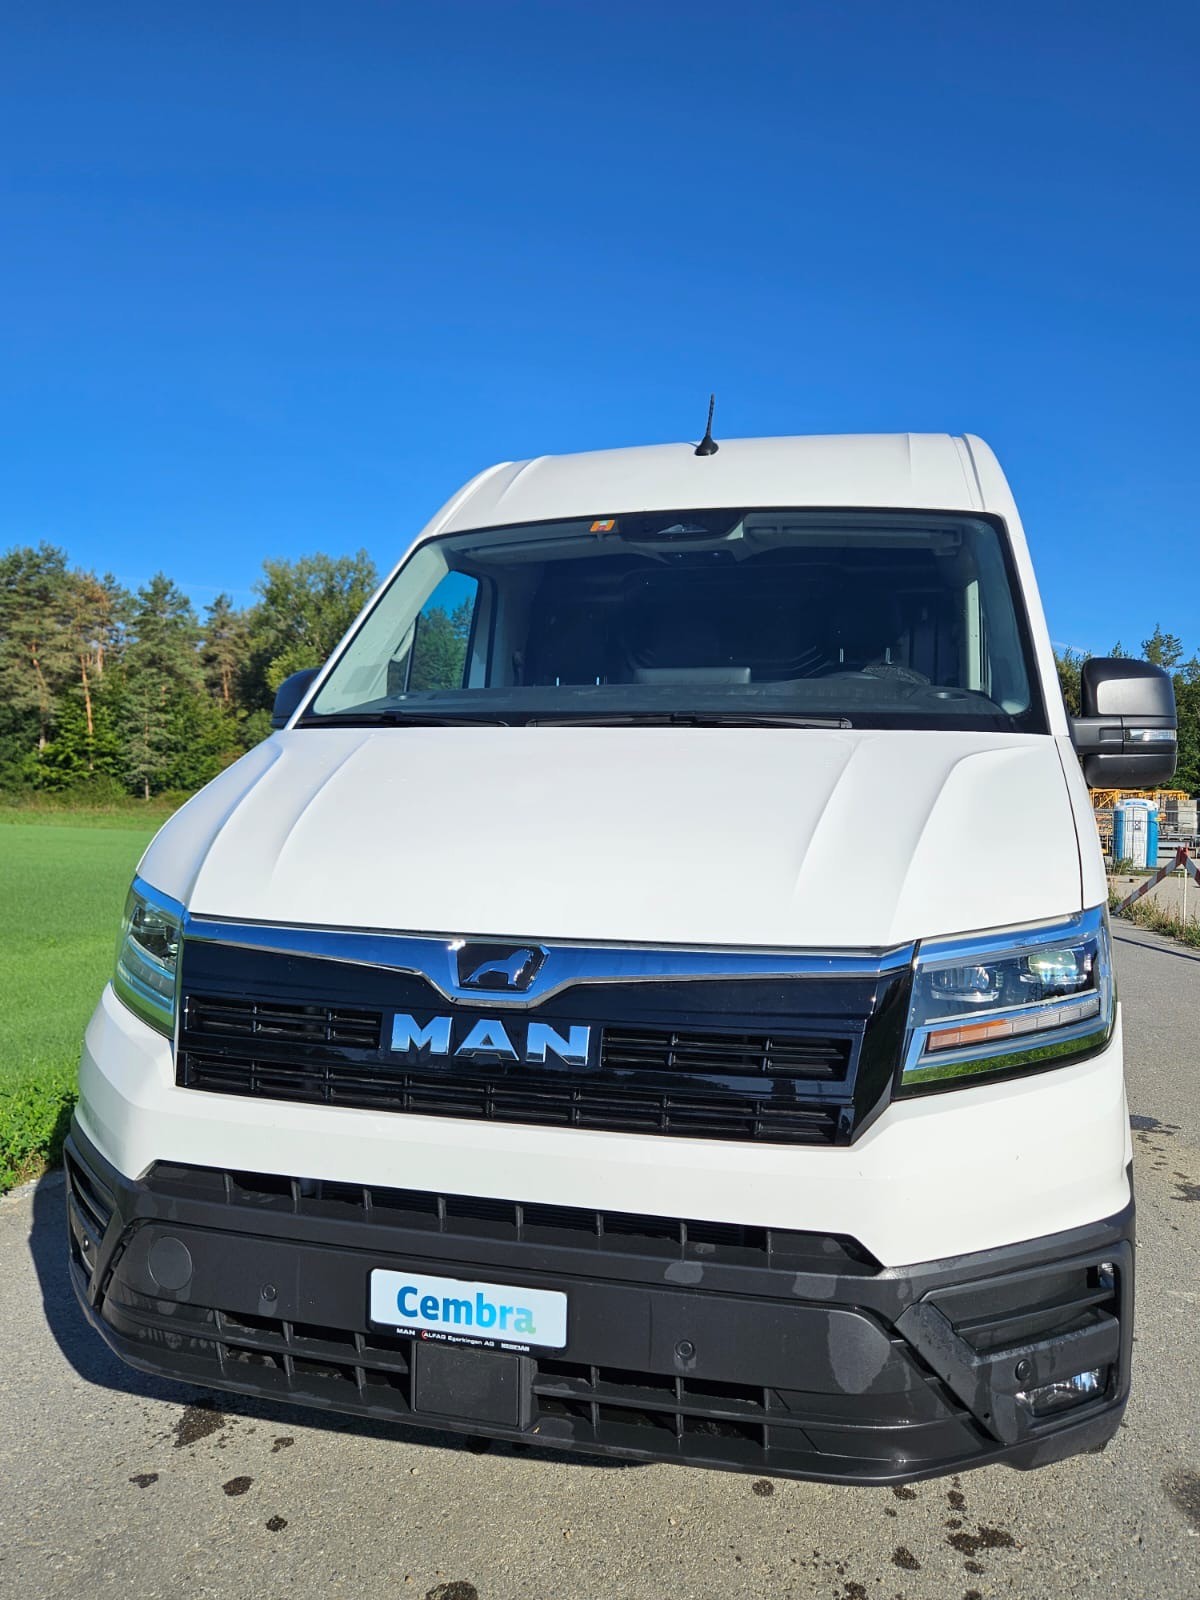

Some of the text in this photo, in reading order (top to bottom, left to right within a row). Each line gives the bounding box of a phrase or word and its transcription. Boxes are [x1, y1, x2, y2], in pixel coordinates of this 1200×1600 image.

[390, 1013, 591, 1066] MAN
[396, 1286, 537, 1335] Cembra
[396, 1327, 416, 1336] MAN
